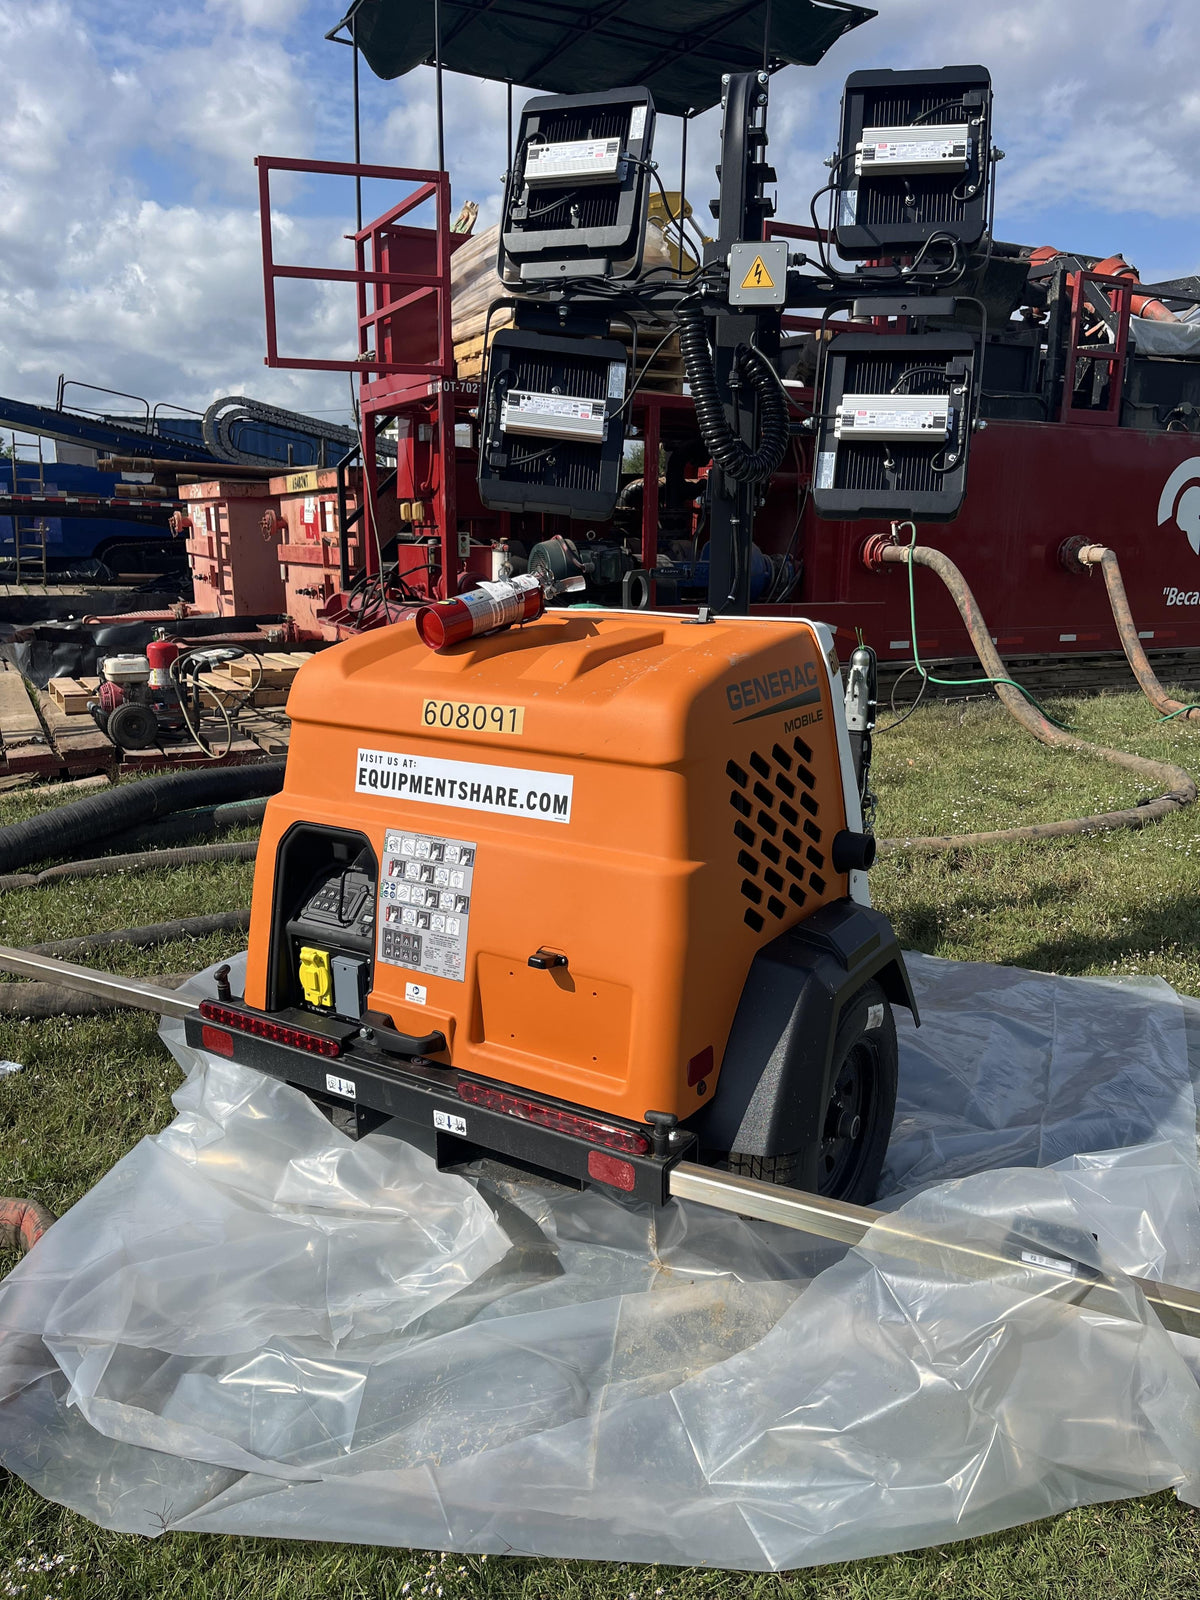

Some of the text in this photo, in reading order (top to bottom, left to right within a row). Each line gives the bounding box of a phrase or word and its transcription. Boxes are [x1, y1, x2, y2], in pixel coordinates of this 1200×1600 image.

[443, 381, 481, 393] OT-702
[1163, 587, 1200, 605] "Beca
[726, 662, 818, 711] GENERAC
[424, 701, 517, 732] 608091
[784, 709, 824, 734] MOBILE
[359, 753, 417, 768] VISIT US AT:
[358, 767, 569, 815] EQUIPMENTSHARE.COM
